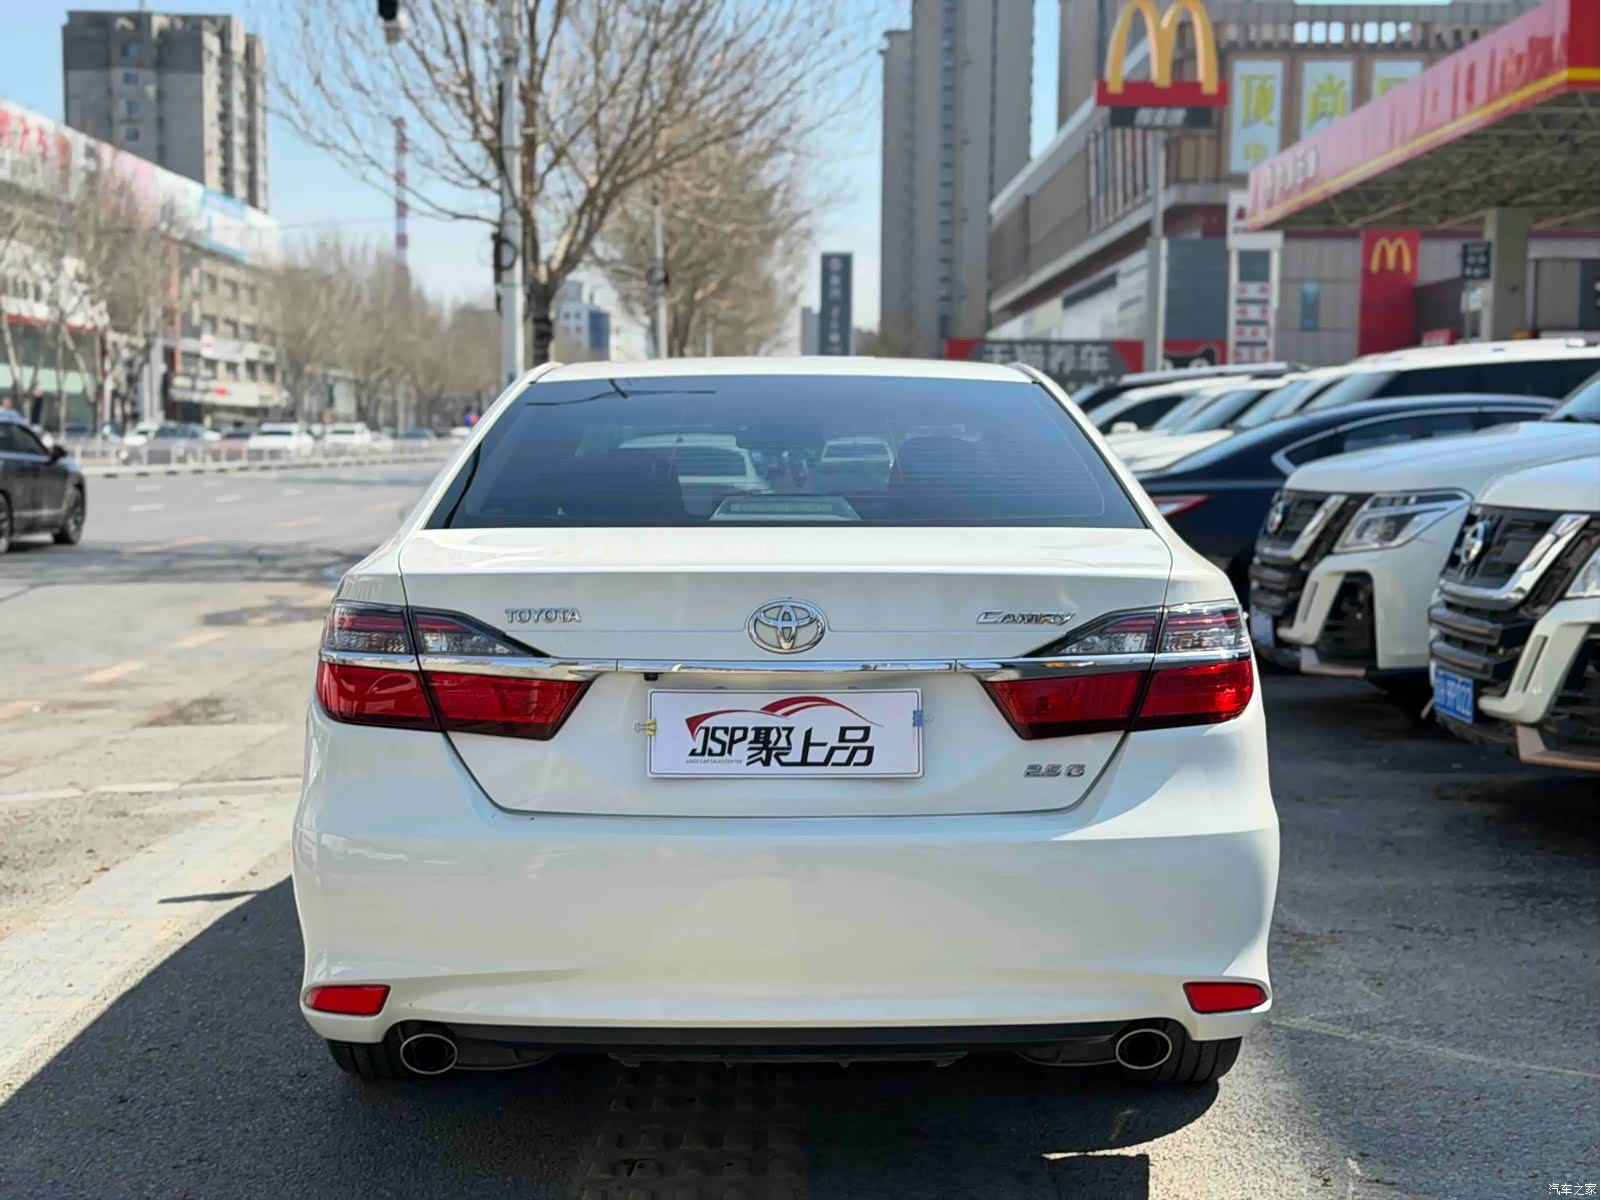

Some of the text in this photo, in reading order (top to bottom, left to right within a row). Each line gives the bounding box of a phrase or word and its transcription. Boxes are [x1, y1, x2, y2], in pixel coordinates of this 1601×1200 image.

[504, 607, 582, 624] TOYOTA
[976, 609, 1076, 626] CAMRY
[1023, 763, 1062, 778] 2.5
